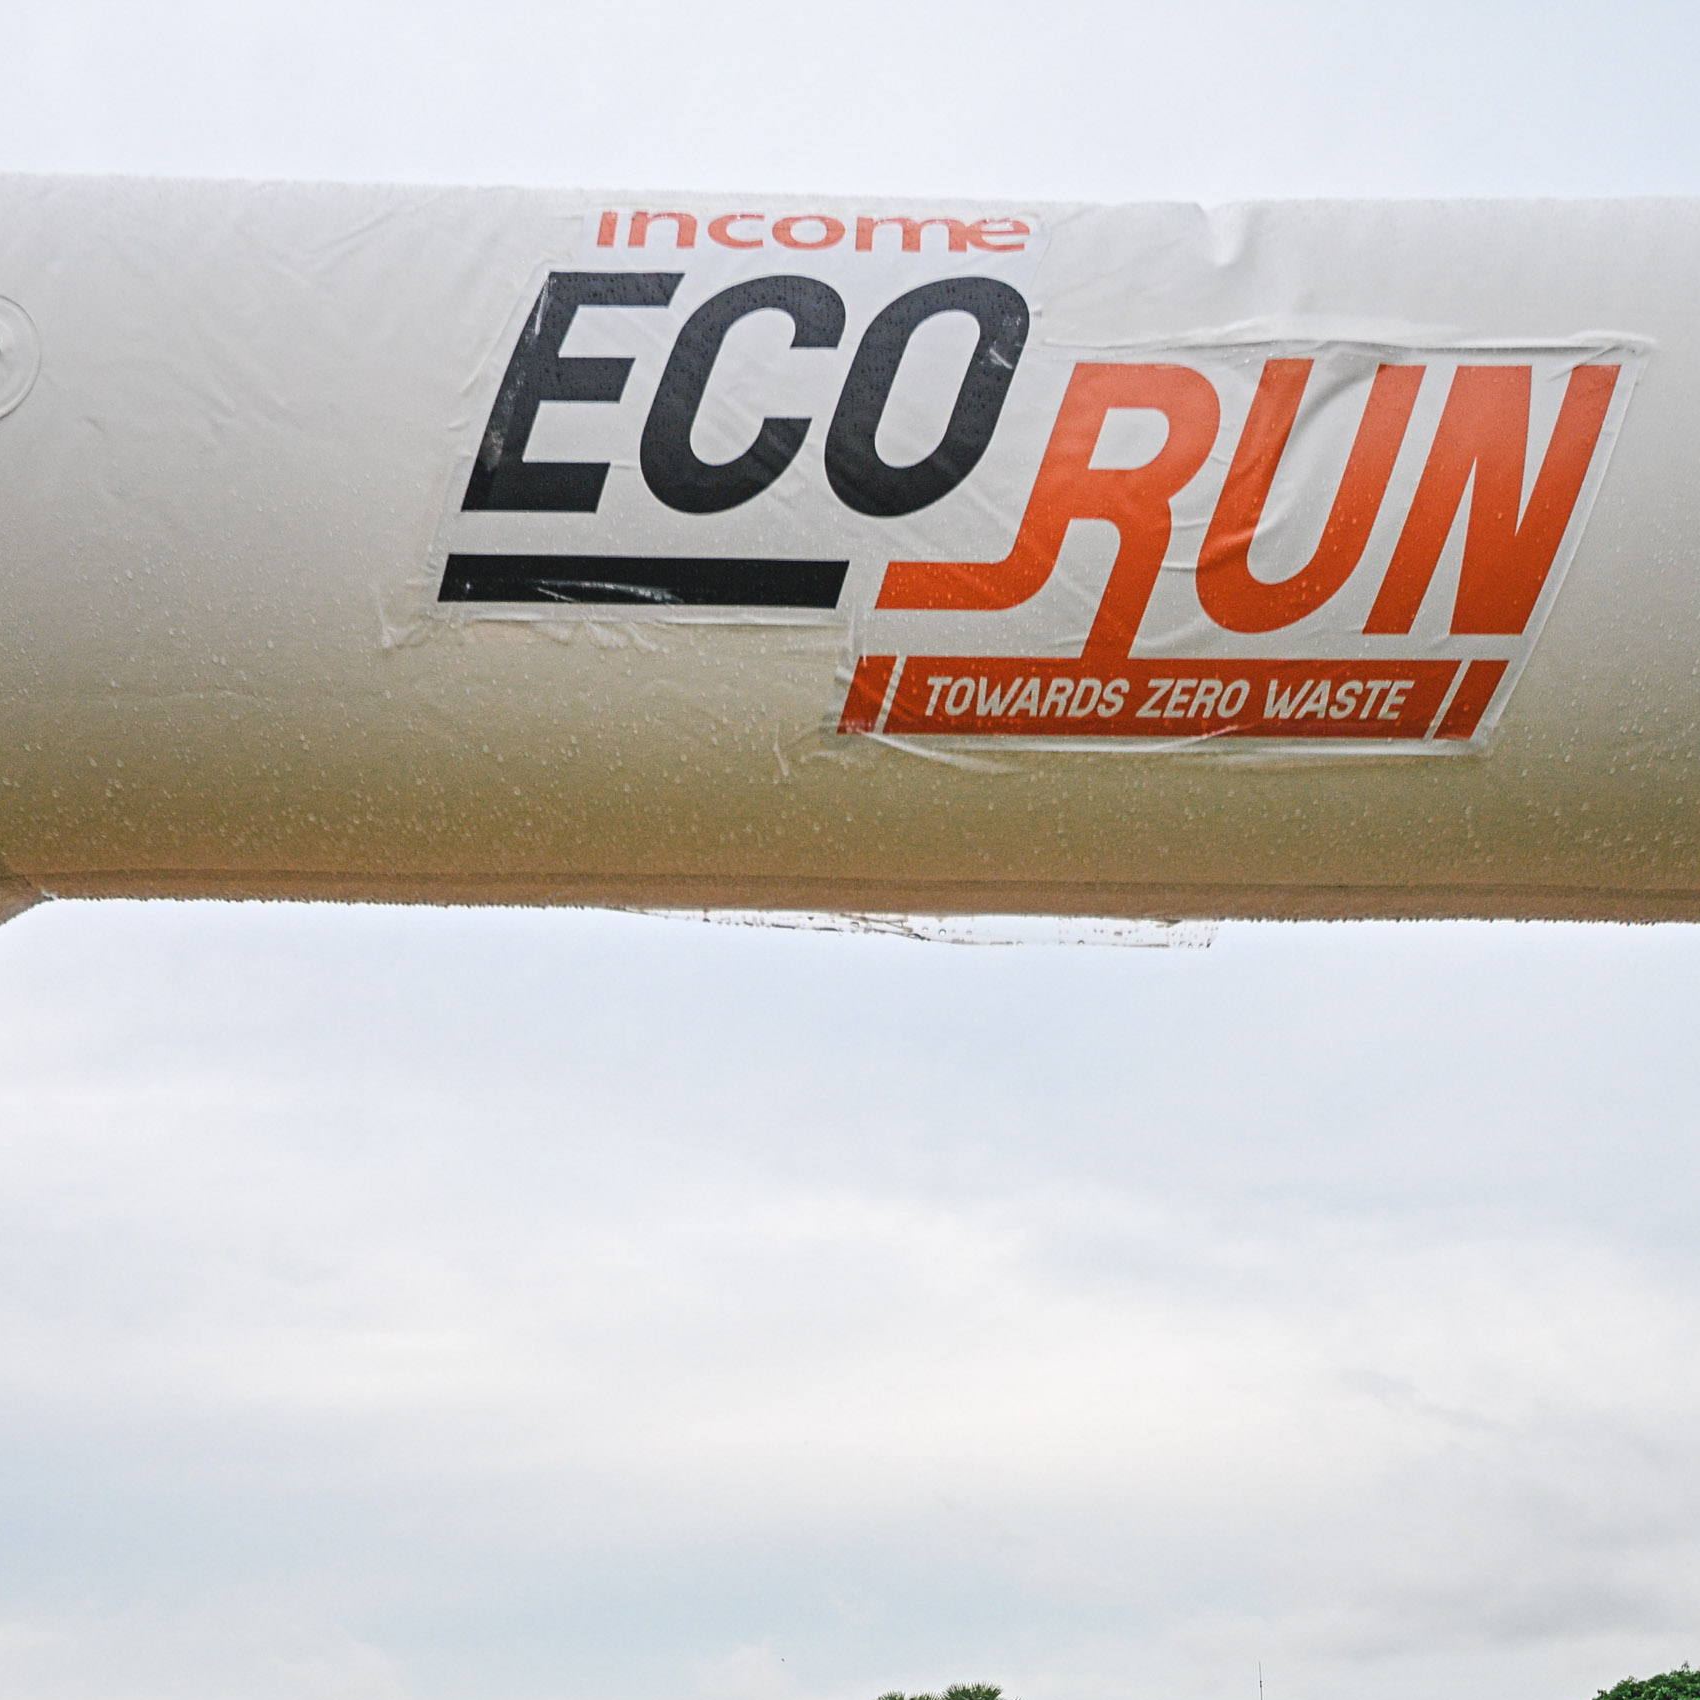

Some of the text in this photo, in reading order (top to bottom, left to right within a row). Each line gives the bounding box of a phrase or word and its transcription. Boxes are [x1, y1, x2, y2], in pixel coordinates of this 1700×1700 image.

[593, 209, 1033, 254] income
[460, 269, 1623, 660] ECO RUN
[924, 676, 1415, 721] TOWARDS ZERO WASTE
